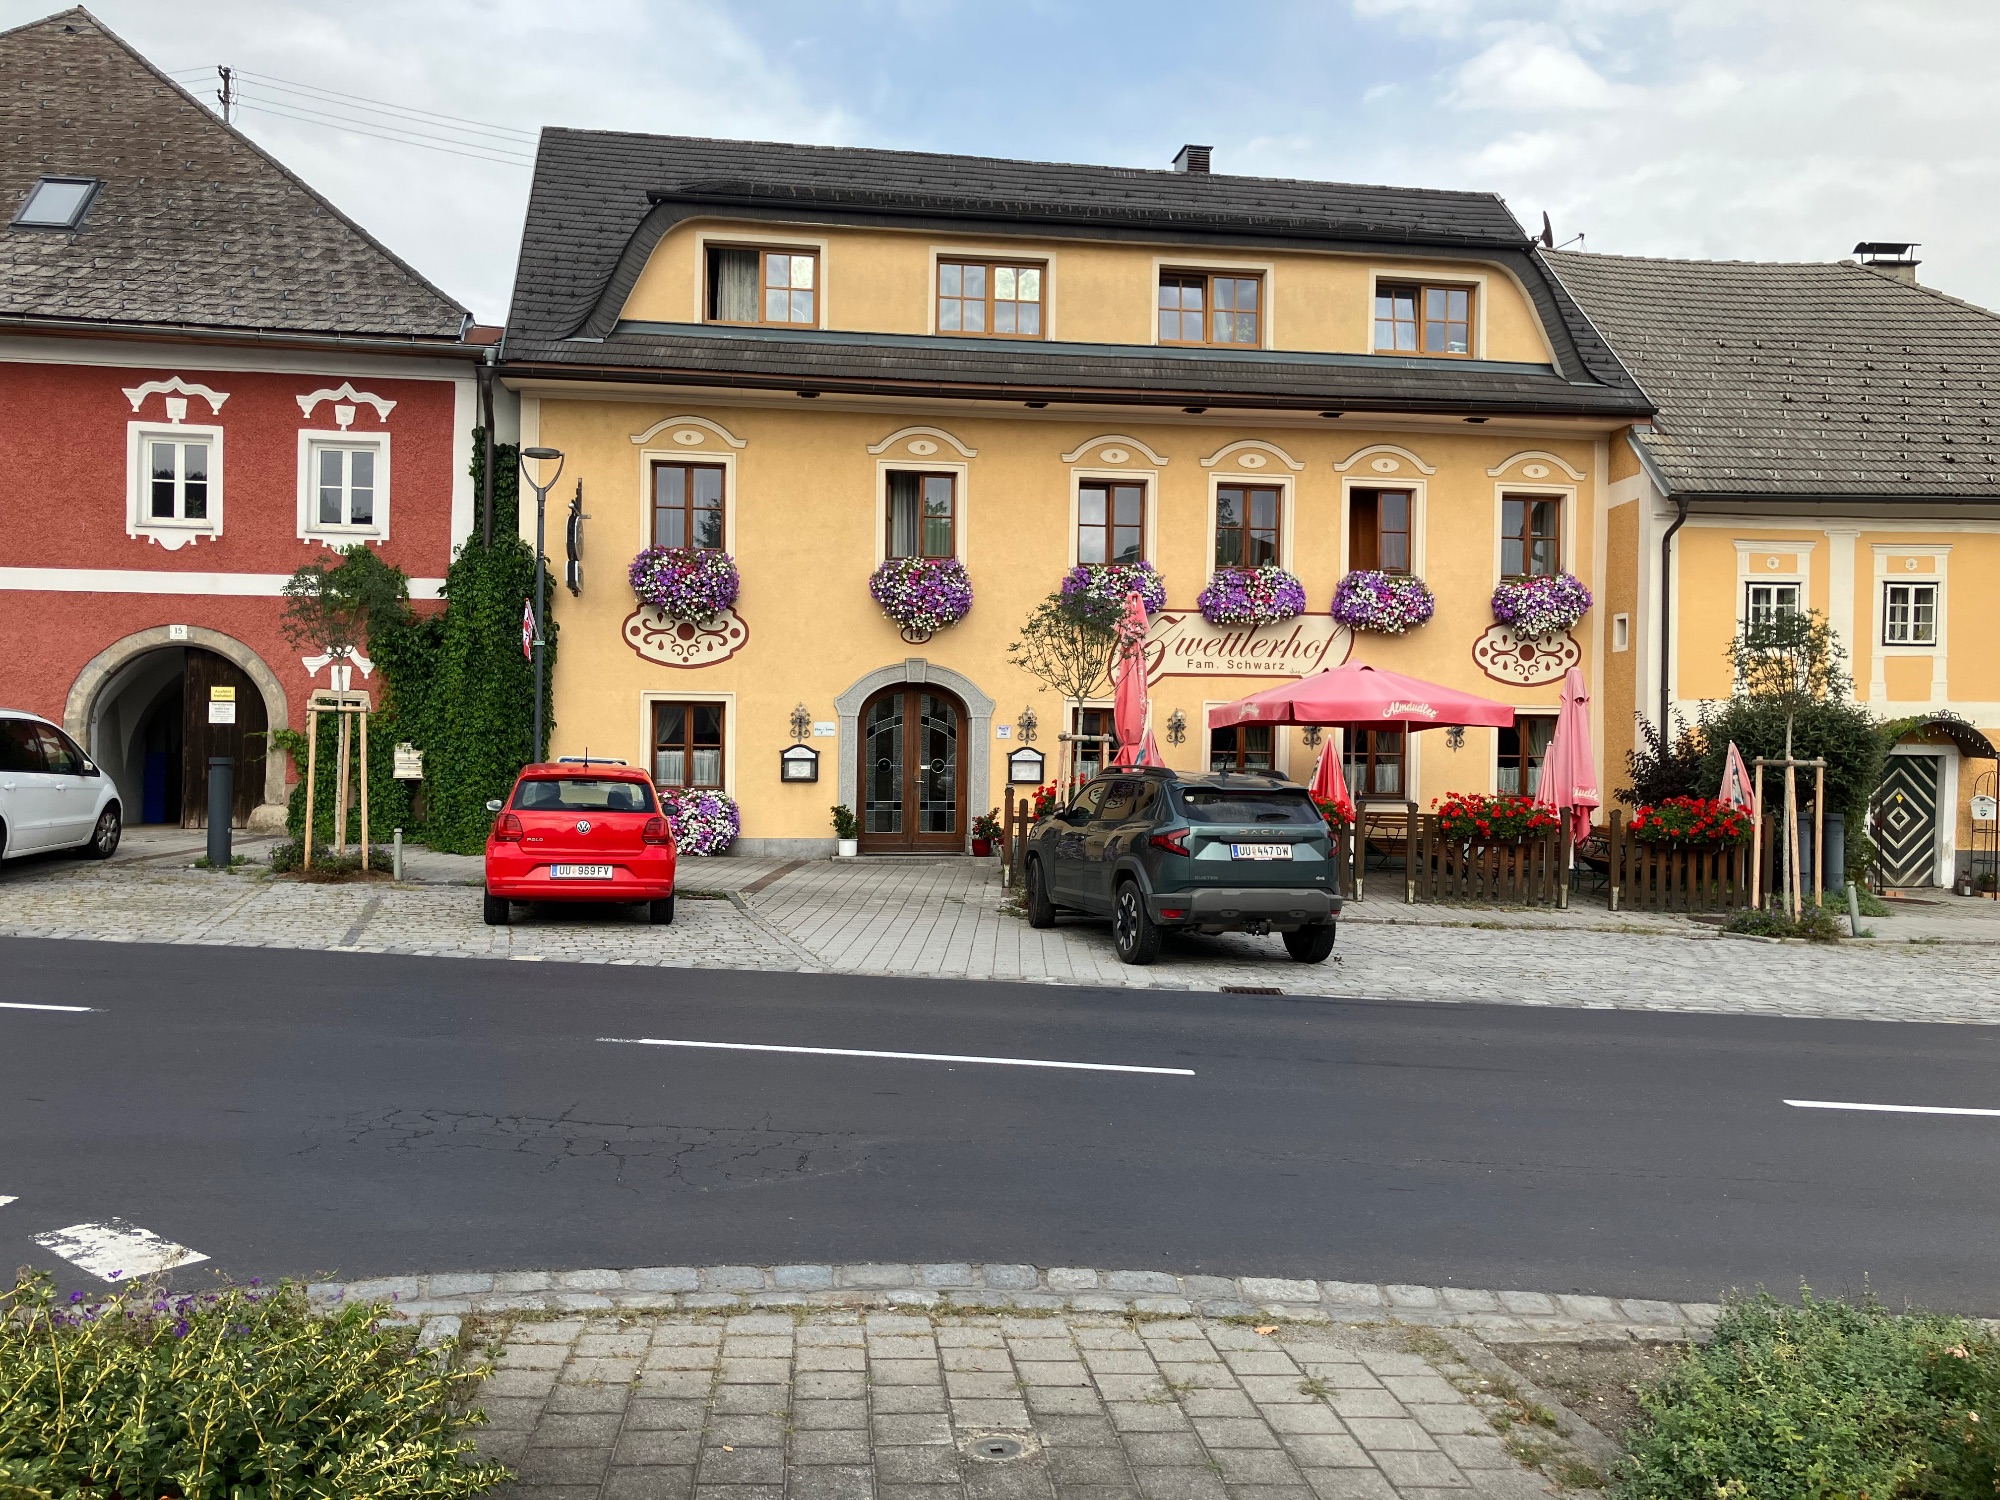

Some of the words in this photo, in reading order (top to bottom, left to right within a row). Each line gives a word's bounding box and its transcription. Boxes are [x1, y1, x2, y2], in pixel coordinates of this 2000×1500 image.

[909, 628, 923, 640] 14
[1144, 615, 1346, 677] Zwettlerhof
[1187, 659, 1219, 670] Fam.
[1227, 660, 1285, 670] Schwarz
[1382, 701, 1439, 719] Almdudler
[1239, 846, 1252, 857] UU
[1257, 846, 1274, 857] 447
[1276, 846, 1289, 857] DW
[559, 866, 571, 876] UU
[577, 866, 596, 876] 969
[597, 866, 609, 875] FV
